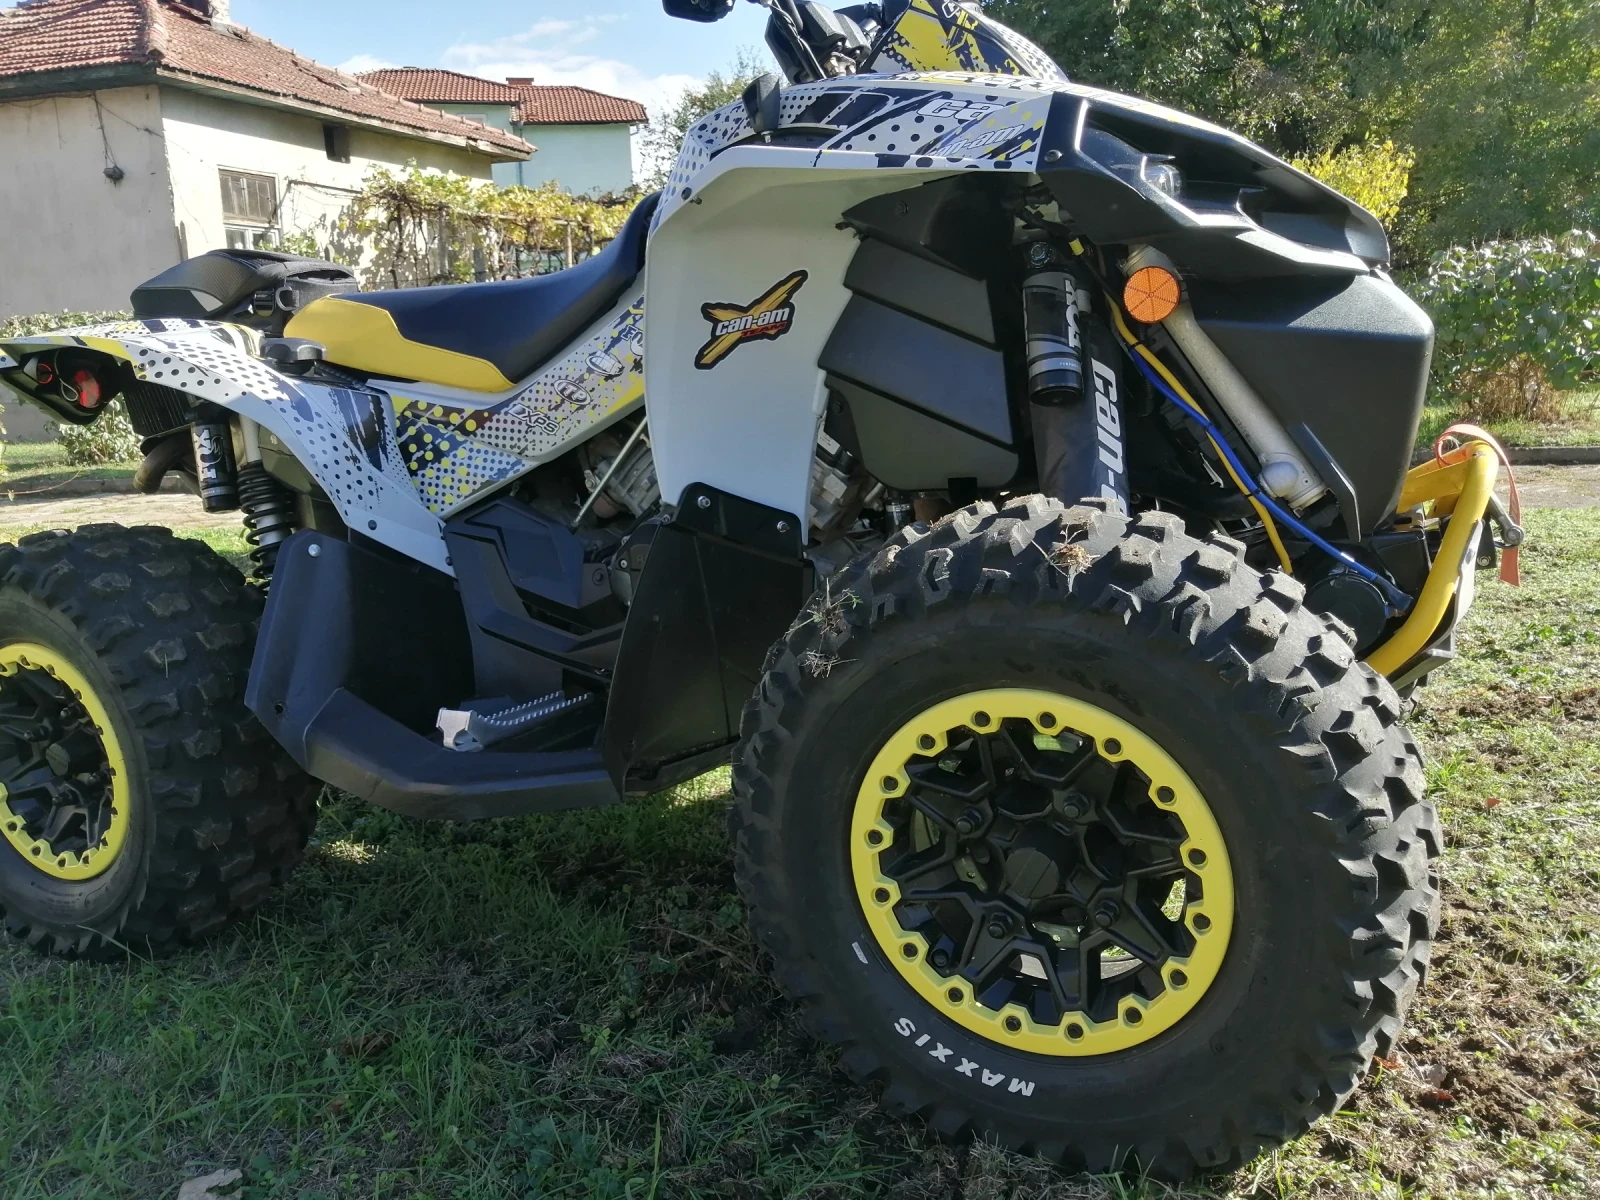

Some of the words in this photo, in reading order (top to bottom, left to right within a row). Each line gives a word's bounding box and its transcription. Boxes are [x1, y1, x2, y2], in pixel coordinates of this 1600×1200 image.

[715, 307, 790, 336] can-am
[557, 382, 588, 403] ITP
[521, 408, 560, 435] XPS
[893, 1017, 1036, 1097] MAXXIS
